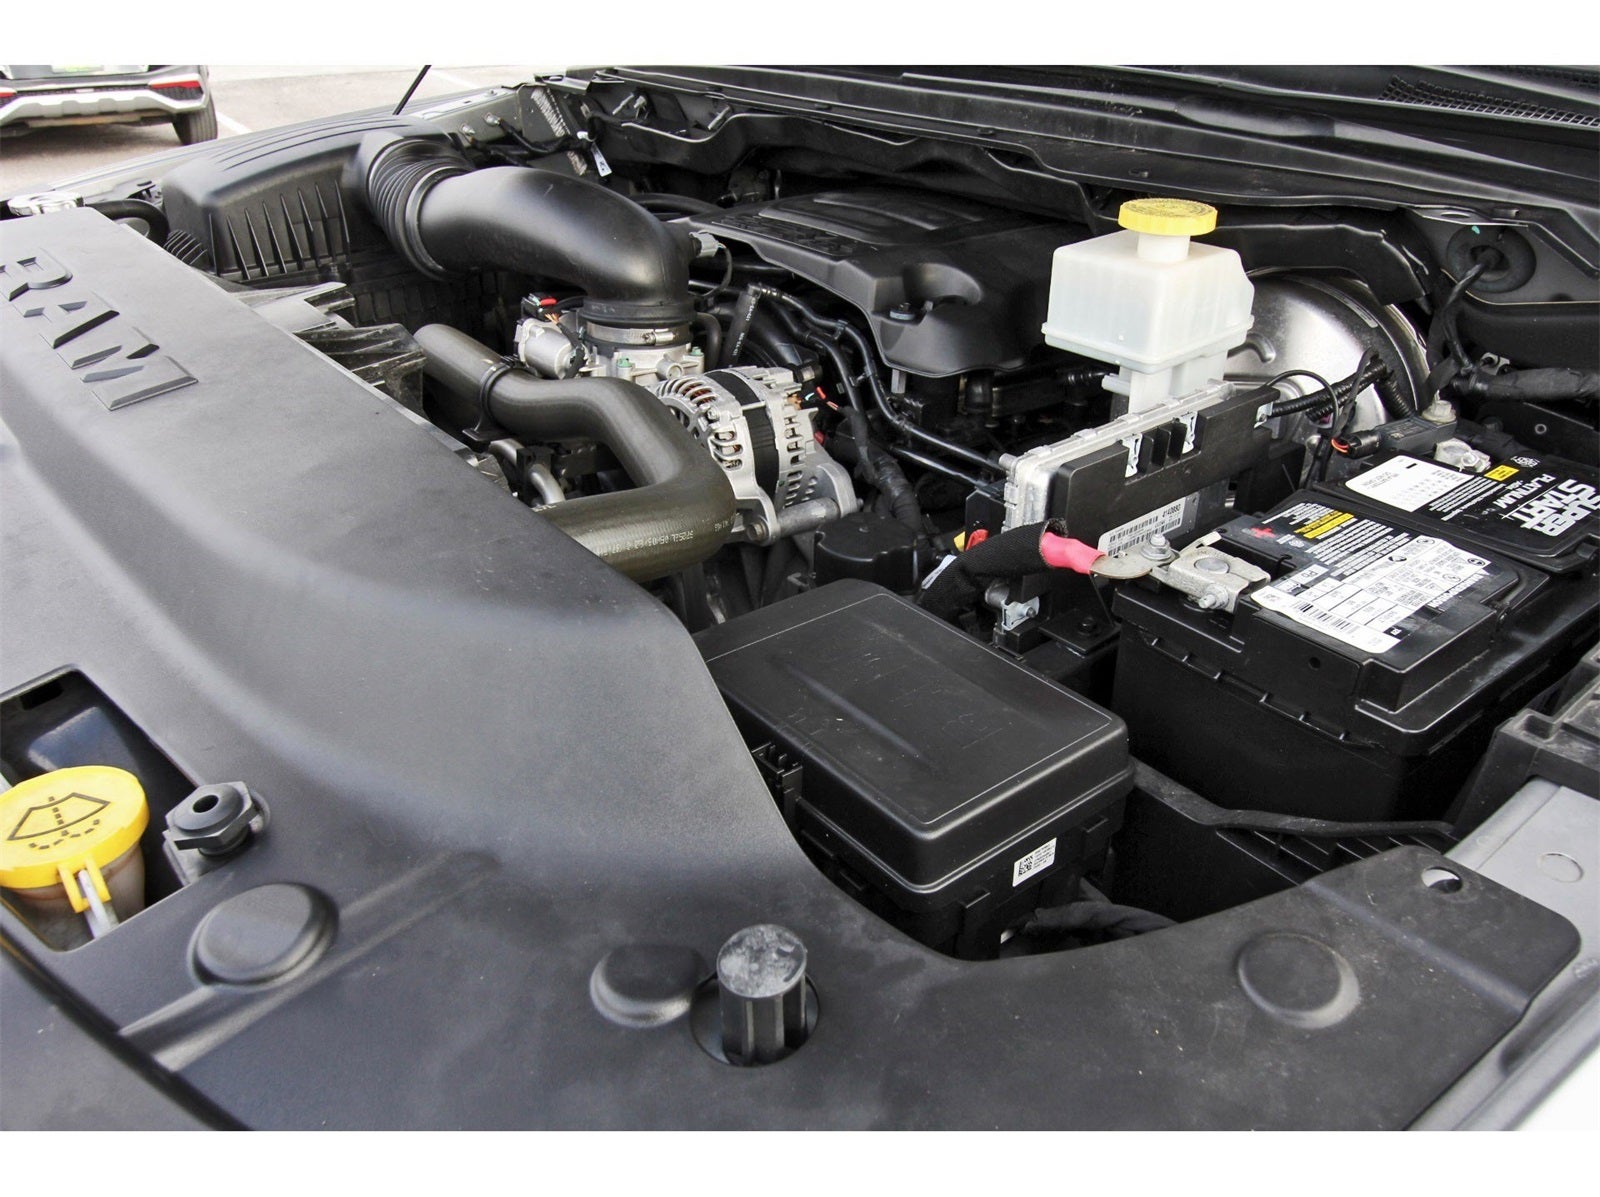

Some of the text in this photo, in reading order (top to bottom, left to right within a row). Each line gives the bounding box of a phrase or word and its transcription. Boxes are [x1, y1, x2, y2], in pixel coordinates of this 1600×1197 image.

[0, 247, 199, 411] RAM
[1492, 473, 1556, 509] PLATINUM
[1520, 479, 1597, 531] START
